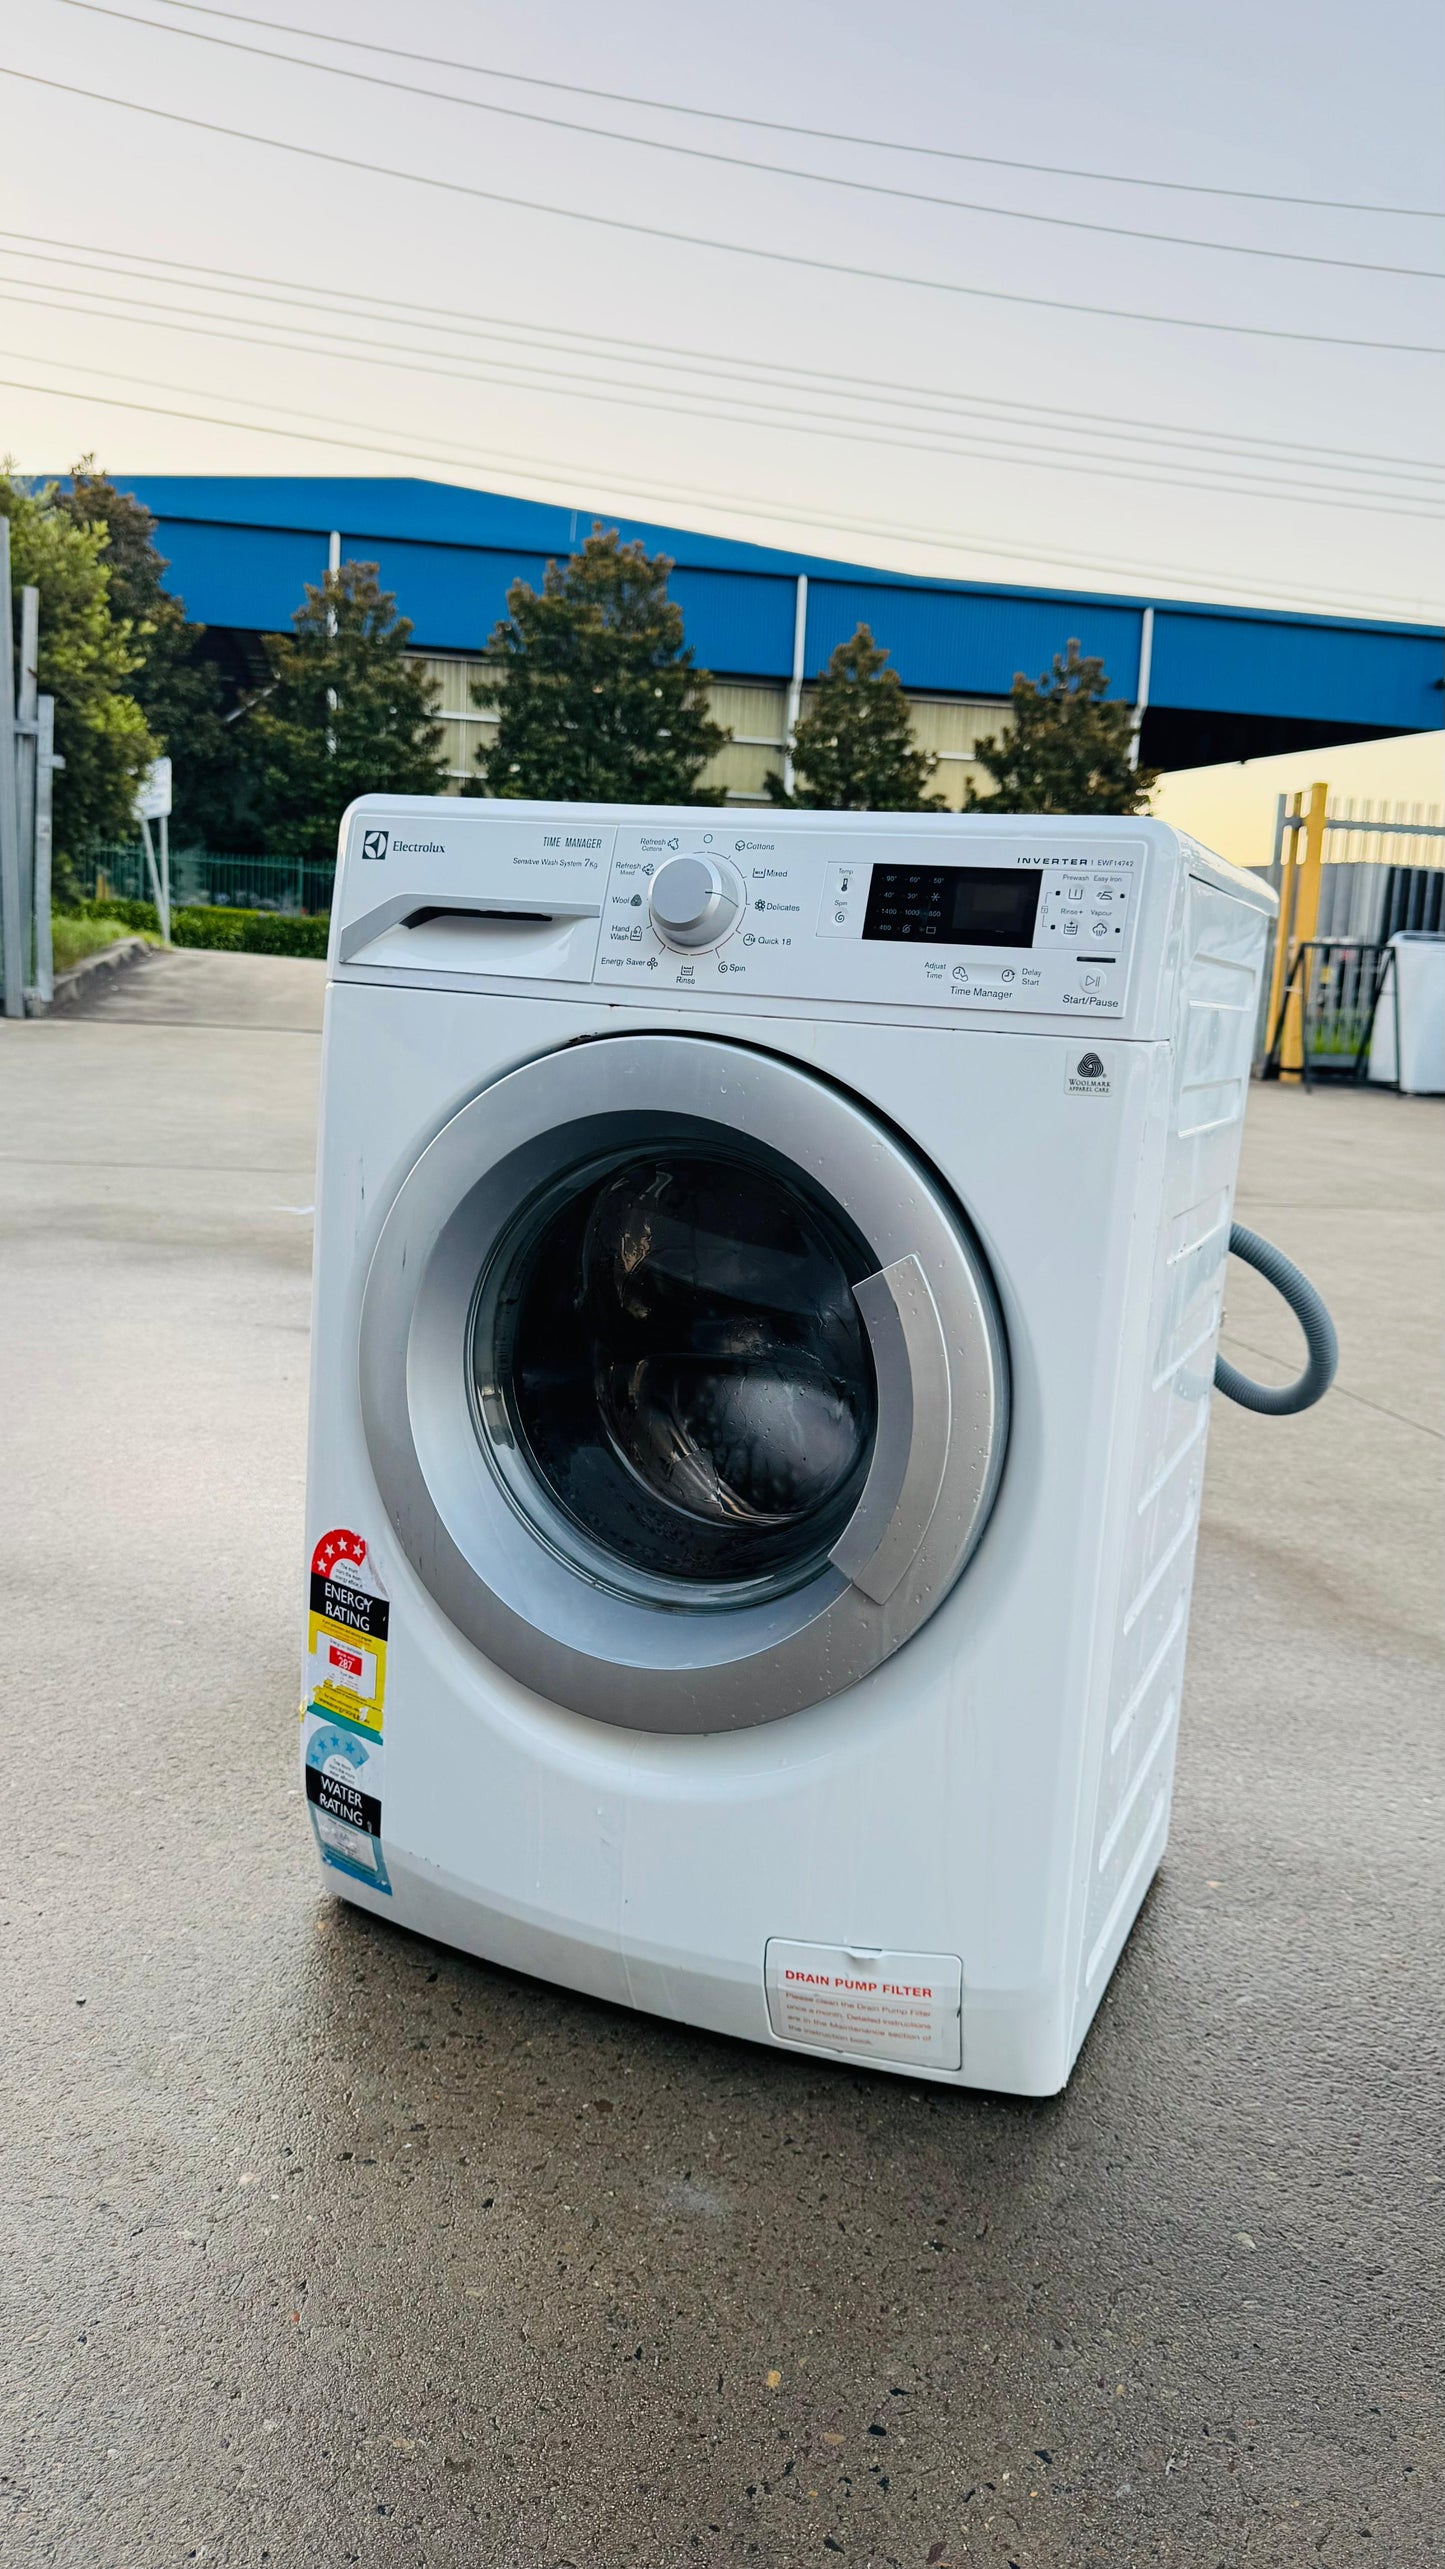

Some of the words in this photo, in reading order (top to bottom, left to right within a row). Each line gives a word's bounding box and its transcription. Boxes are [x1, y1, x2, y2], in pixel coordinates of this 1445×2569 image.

[393, 841, 445, 853] Electrolux
[544, 837, 561, 847] TIME
[565, 838, 602, 848] MANAGER
[746, 842, 775, 850] Cottons
[513, 857, 540, 865] Sensitive
[560, 859, 582, 867] System
[766, 903, 800, 912] Delicates
[758, 936, 779, 944] Quick
[601, 958, 624, 966] Energy
[626, 958, 645, 966] Saver
[924, 962, 946, 970] Adjust
[729, 964, 745, 972] Spin
[1022, 969, 1042, 977] Delay
[676, 976, 695, 984] Rinse
[1022, 978, 1039, 986] Start
[950, 986, 970, 996] Time
[973, 988, 1013, 1000] Manager
[1062, 994, 1118, 1008] Start/Pause
[1069, 1078, 1111, 1087] WOOLMARK
[324, 1582, 373, 1613] ENERGY
[326, 1601, 370, 1631] RATING
[338, 1656, 352, 1670] 287
[321, 1775, 362, 1809] WATER
[320, 1793, 363, 1826] RATING
[785, 1970, 829, 1986] DRAIN
[835, 1978, 877, 1991] PUMP
[883, 1984, 932, 1998] FILTER
